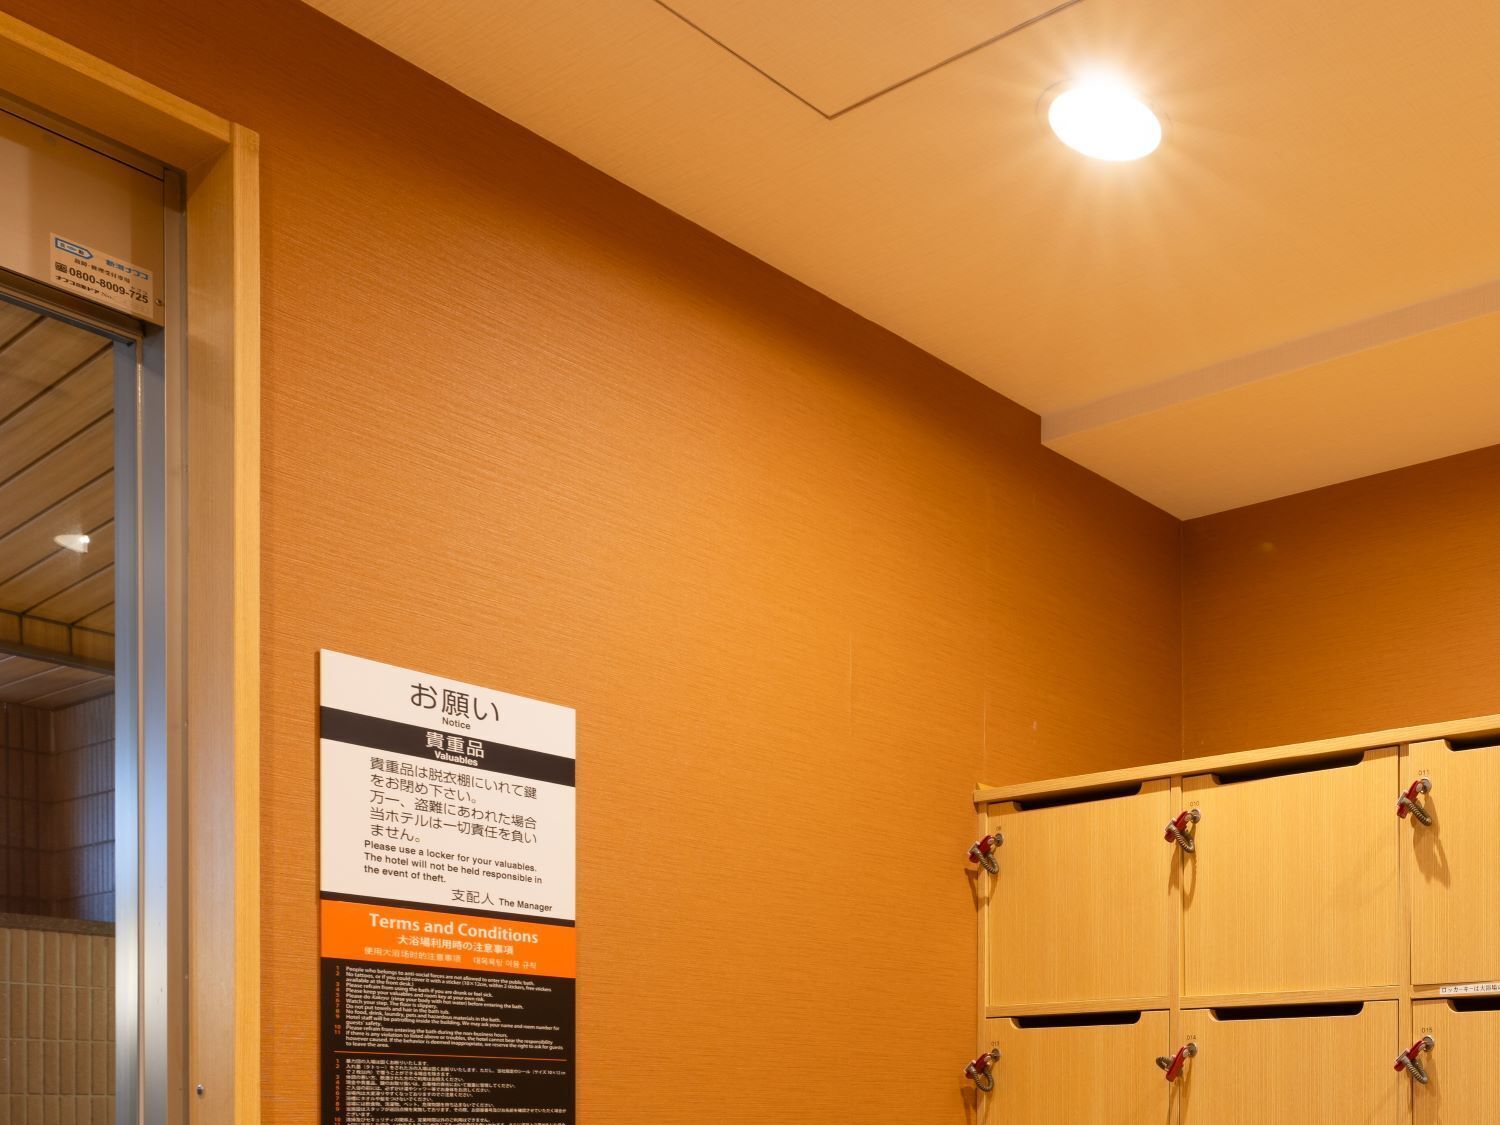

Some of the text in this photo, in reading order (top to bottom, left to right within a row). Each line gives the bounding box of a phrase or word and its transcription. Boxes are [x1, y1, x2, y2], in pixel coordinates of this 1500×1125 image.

[69, 267, 149, 304] 0800-8009-725
[410, 682, 500, 722] お願い
[442, 717, 471, 730] Notice
[425, 731, 485, 759] 貴重品
[434, 750, 478, 767] Valuables
[369, 756, 537, 800] 貴重品は脱衣棚にいれて鍵
[370, 773, 476, 804] をお閉め下さい。
[369, 790, 537, 830] 万一、盗難にあわれた場合
[370, 807, 537, 844] 当ホテルは一切責任を負い
[371, 824, 421, 843] ません。
[364, 840, 537, 872] Please use a locker for your valuables.
[364, 852, 542, 885] The hotel will not be held responsible in
[364, 865, 446, 883] the event of theft.
[451, 888, 552, 913] 支配人 The Manager
[369, 913, 538, 944] Terms and Conditions
[397, 935, 514, 956] 大浴場利用時の注意事項
